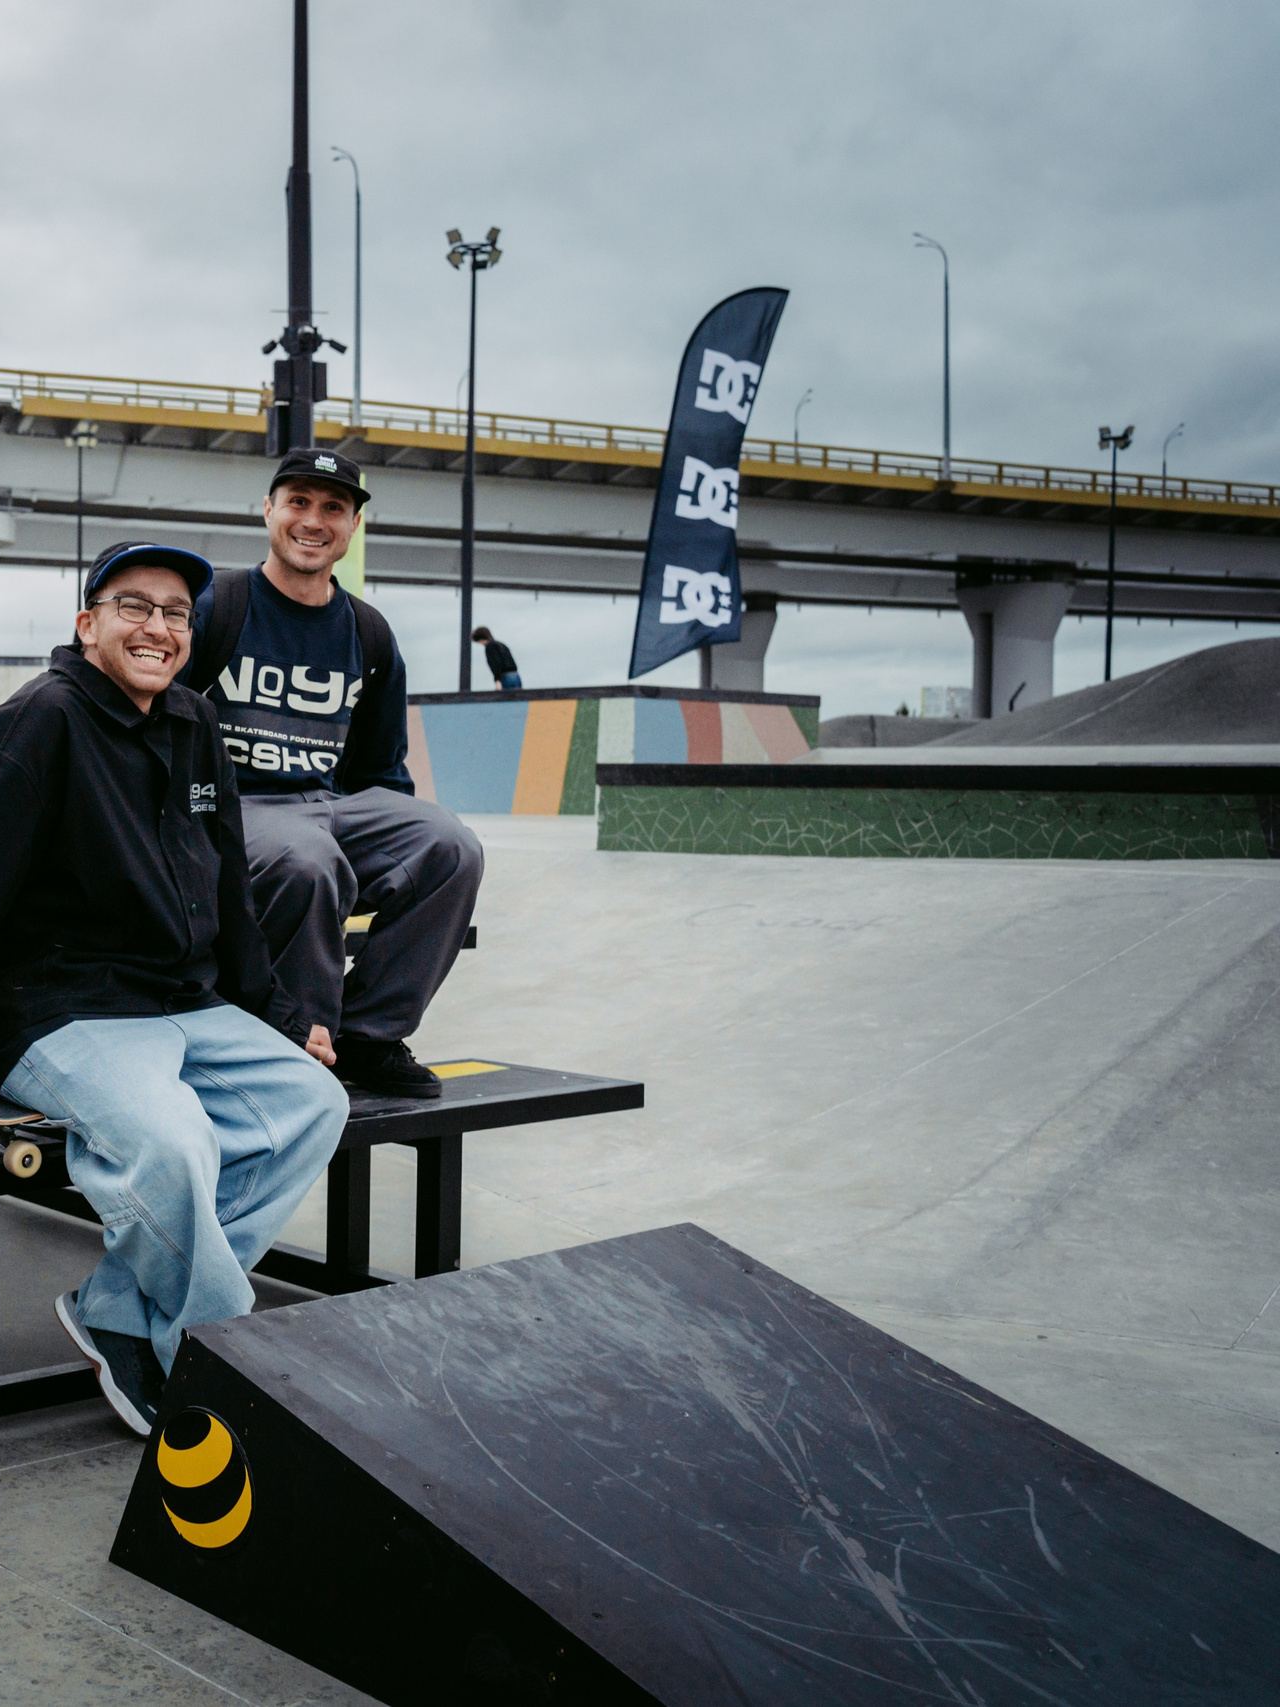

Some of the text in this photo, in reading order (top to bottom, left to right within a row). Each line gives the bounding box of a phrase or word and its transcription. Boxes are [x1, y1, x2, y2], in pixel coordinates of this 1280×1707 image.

[694, 348, 761, 425] DC
[675, 455, 740, 530] DC
[659, 564, 732, 628] DC
[234, 725, 289, 741] SKATEBOARD
[289, 734, 335, 748] FOOTWEAR
[190, 783, 217, 799] 94
